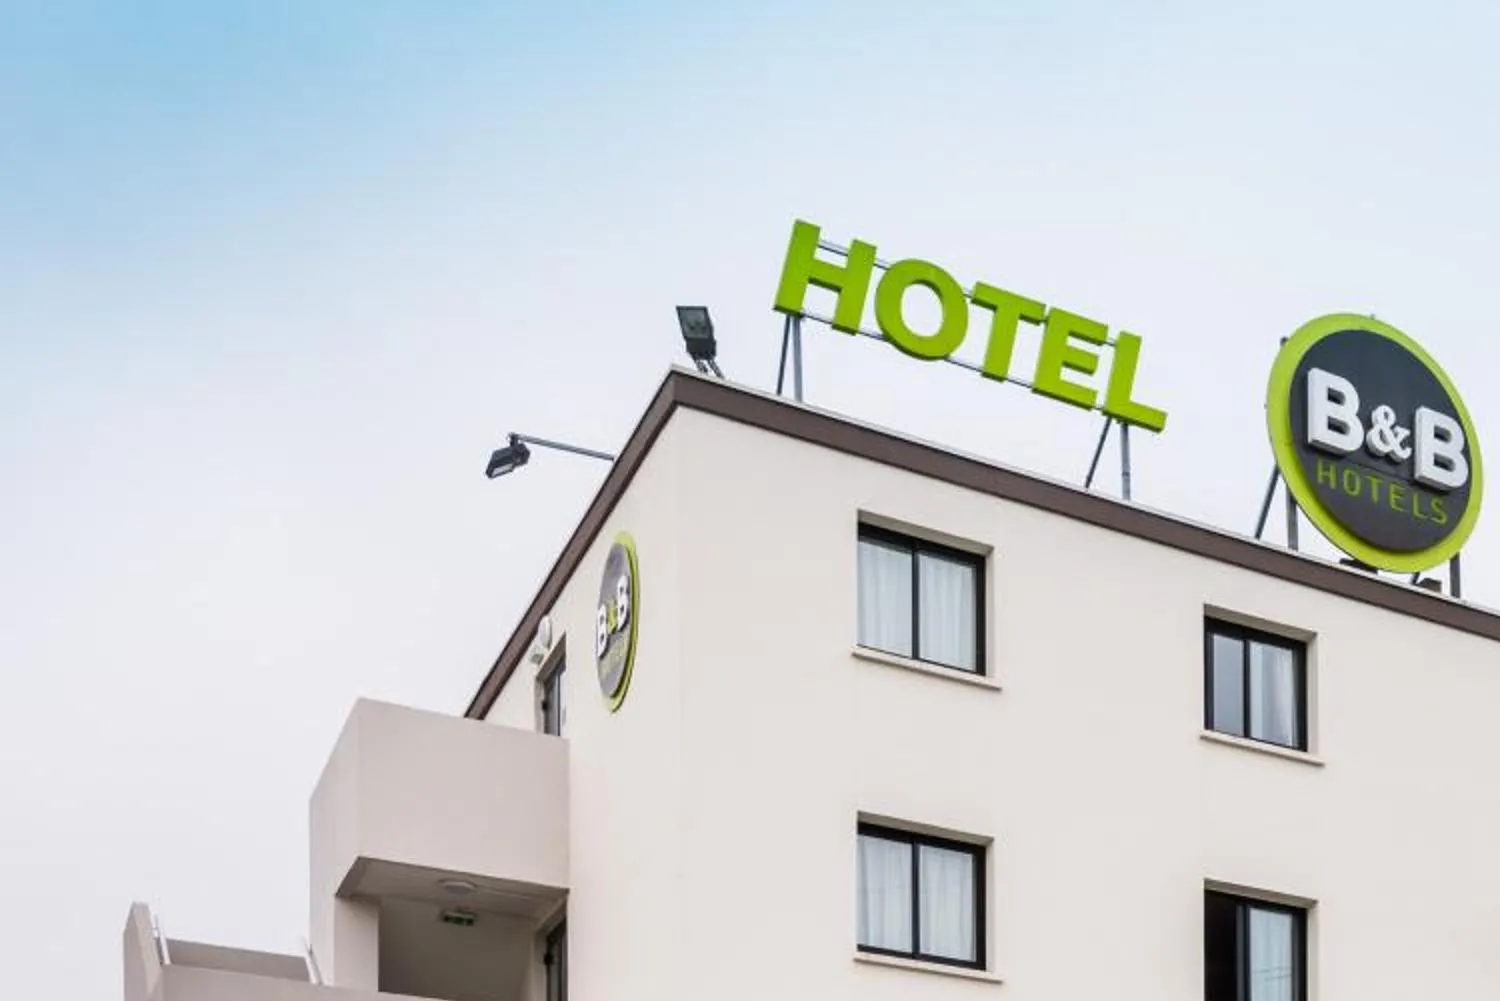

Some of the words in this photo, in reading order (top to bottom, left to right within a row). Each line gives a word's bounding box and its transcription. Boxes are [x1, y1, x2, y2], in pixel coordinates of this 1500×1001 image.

[774, 219, 1168, 433] HOTEL
[1307, 367, 1469, 491] B&B
[1316, 459, 1448, 525] HOTELS
